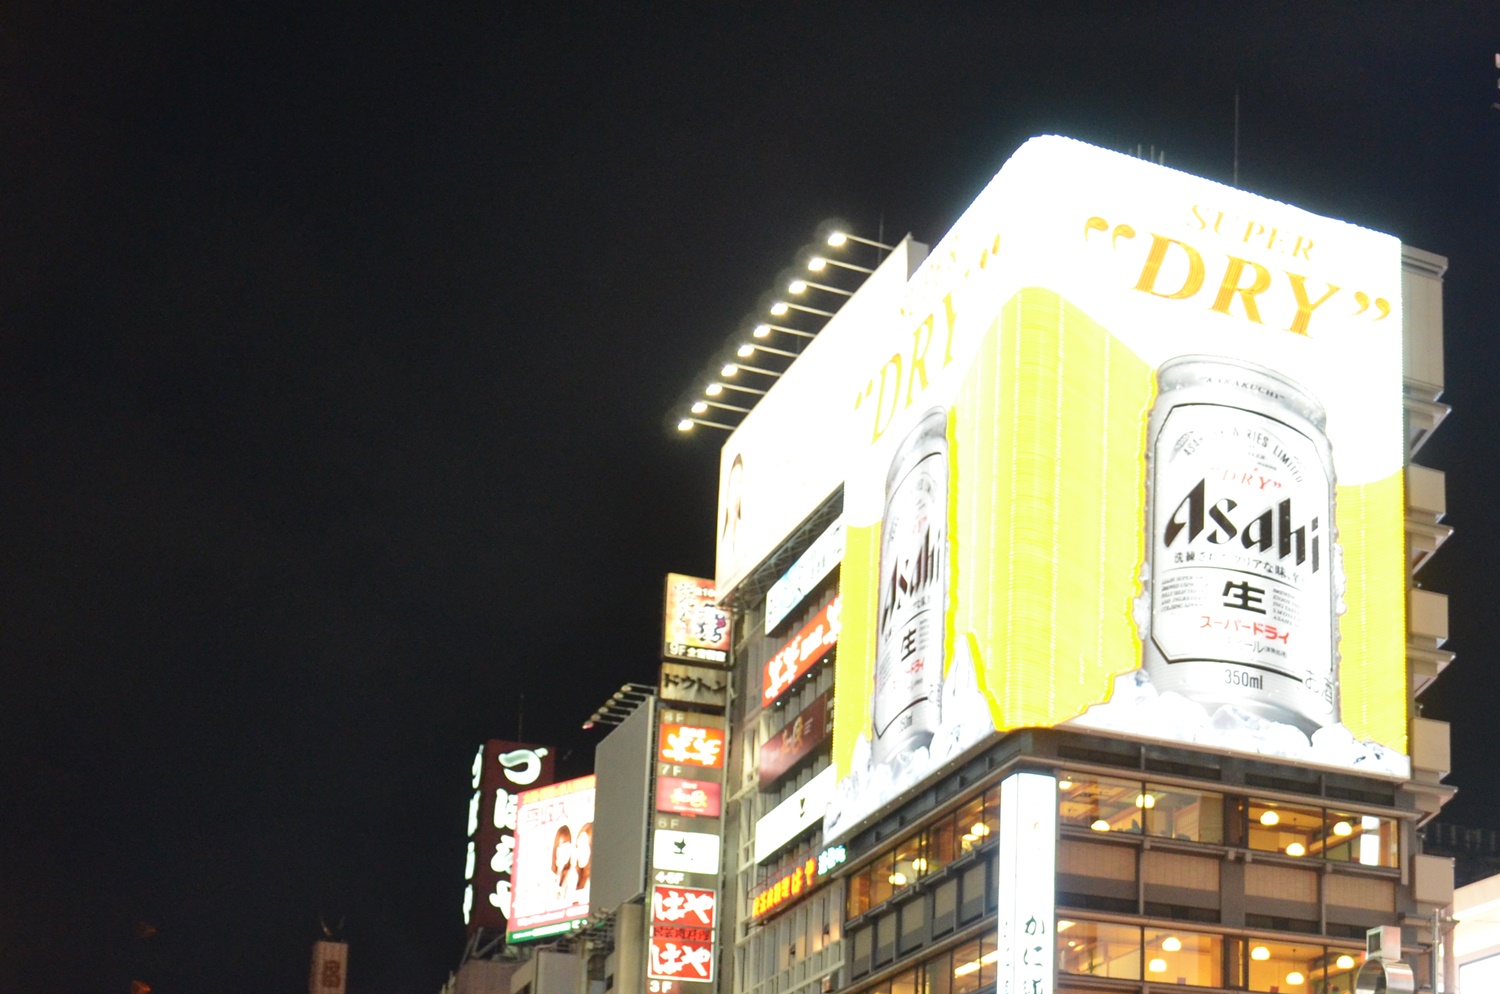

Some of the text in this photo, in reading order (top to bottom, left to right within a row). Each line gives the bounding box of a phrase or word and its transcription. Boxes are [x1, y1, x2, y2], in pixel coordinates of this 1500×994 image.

[1188, 203, 1316, 262] SUPER
[1163, 477, 1322, 576] Asahi
[1221, 580, 1267, 616] 生
[1199, 615, 1290, 645] スーパードライ
[1224, 668, 1264, 691] 350ml
[661, 764, 682, 777] 7F
[653, 889, 714, 925] はや
[650, 942, 711, 977] はや
[649, 980, 672, 993] 3F
